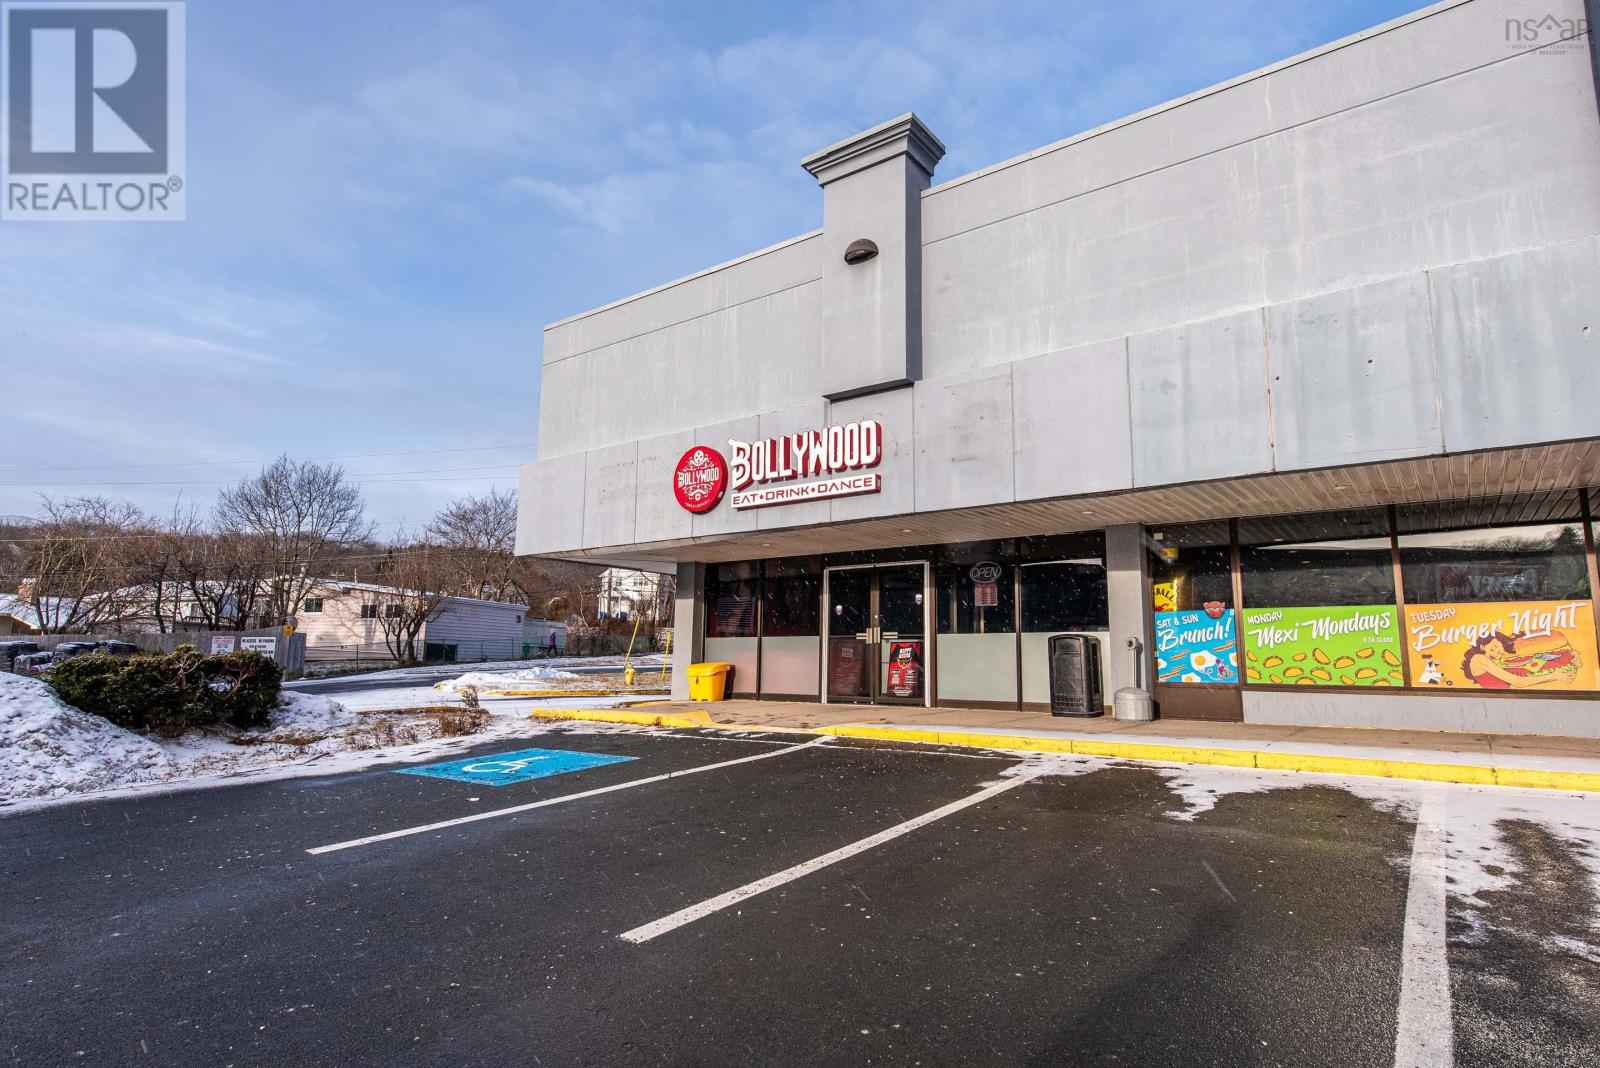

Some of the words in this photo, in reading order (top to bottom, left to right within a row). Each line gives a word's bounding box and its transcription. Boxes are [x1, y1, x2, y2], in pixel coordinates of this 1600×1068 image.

[728, 419, 879, 489] BOLLYWOOD
[677, 467, 720, 488] BOLLYWOOD
[733, 494, 756, 505] EAT
[766, 487, 810, 501] DRINK
[818, 477, 873, 493] DANCE
[970, 565, 998, 578] OPEN
[1156, 619, 1173, 629] SAT
[1173, 617, 1180, 625] &
[1181, 613, 1199, 624] SUN
[1247, 611, 1283, 625] MONDAY
[1410, 607, 1456, 625] TUESDAY
[1411, 620, 1504, 653] Burger
[1508, 601, 1588, 639] Night
[1157, 617, 1232, 652] Brunch!
[1247, 623, 1301, 649] Mexi
[1301, 611, 1391, 642] Mondays
